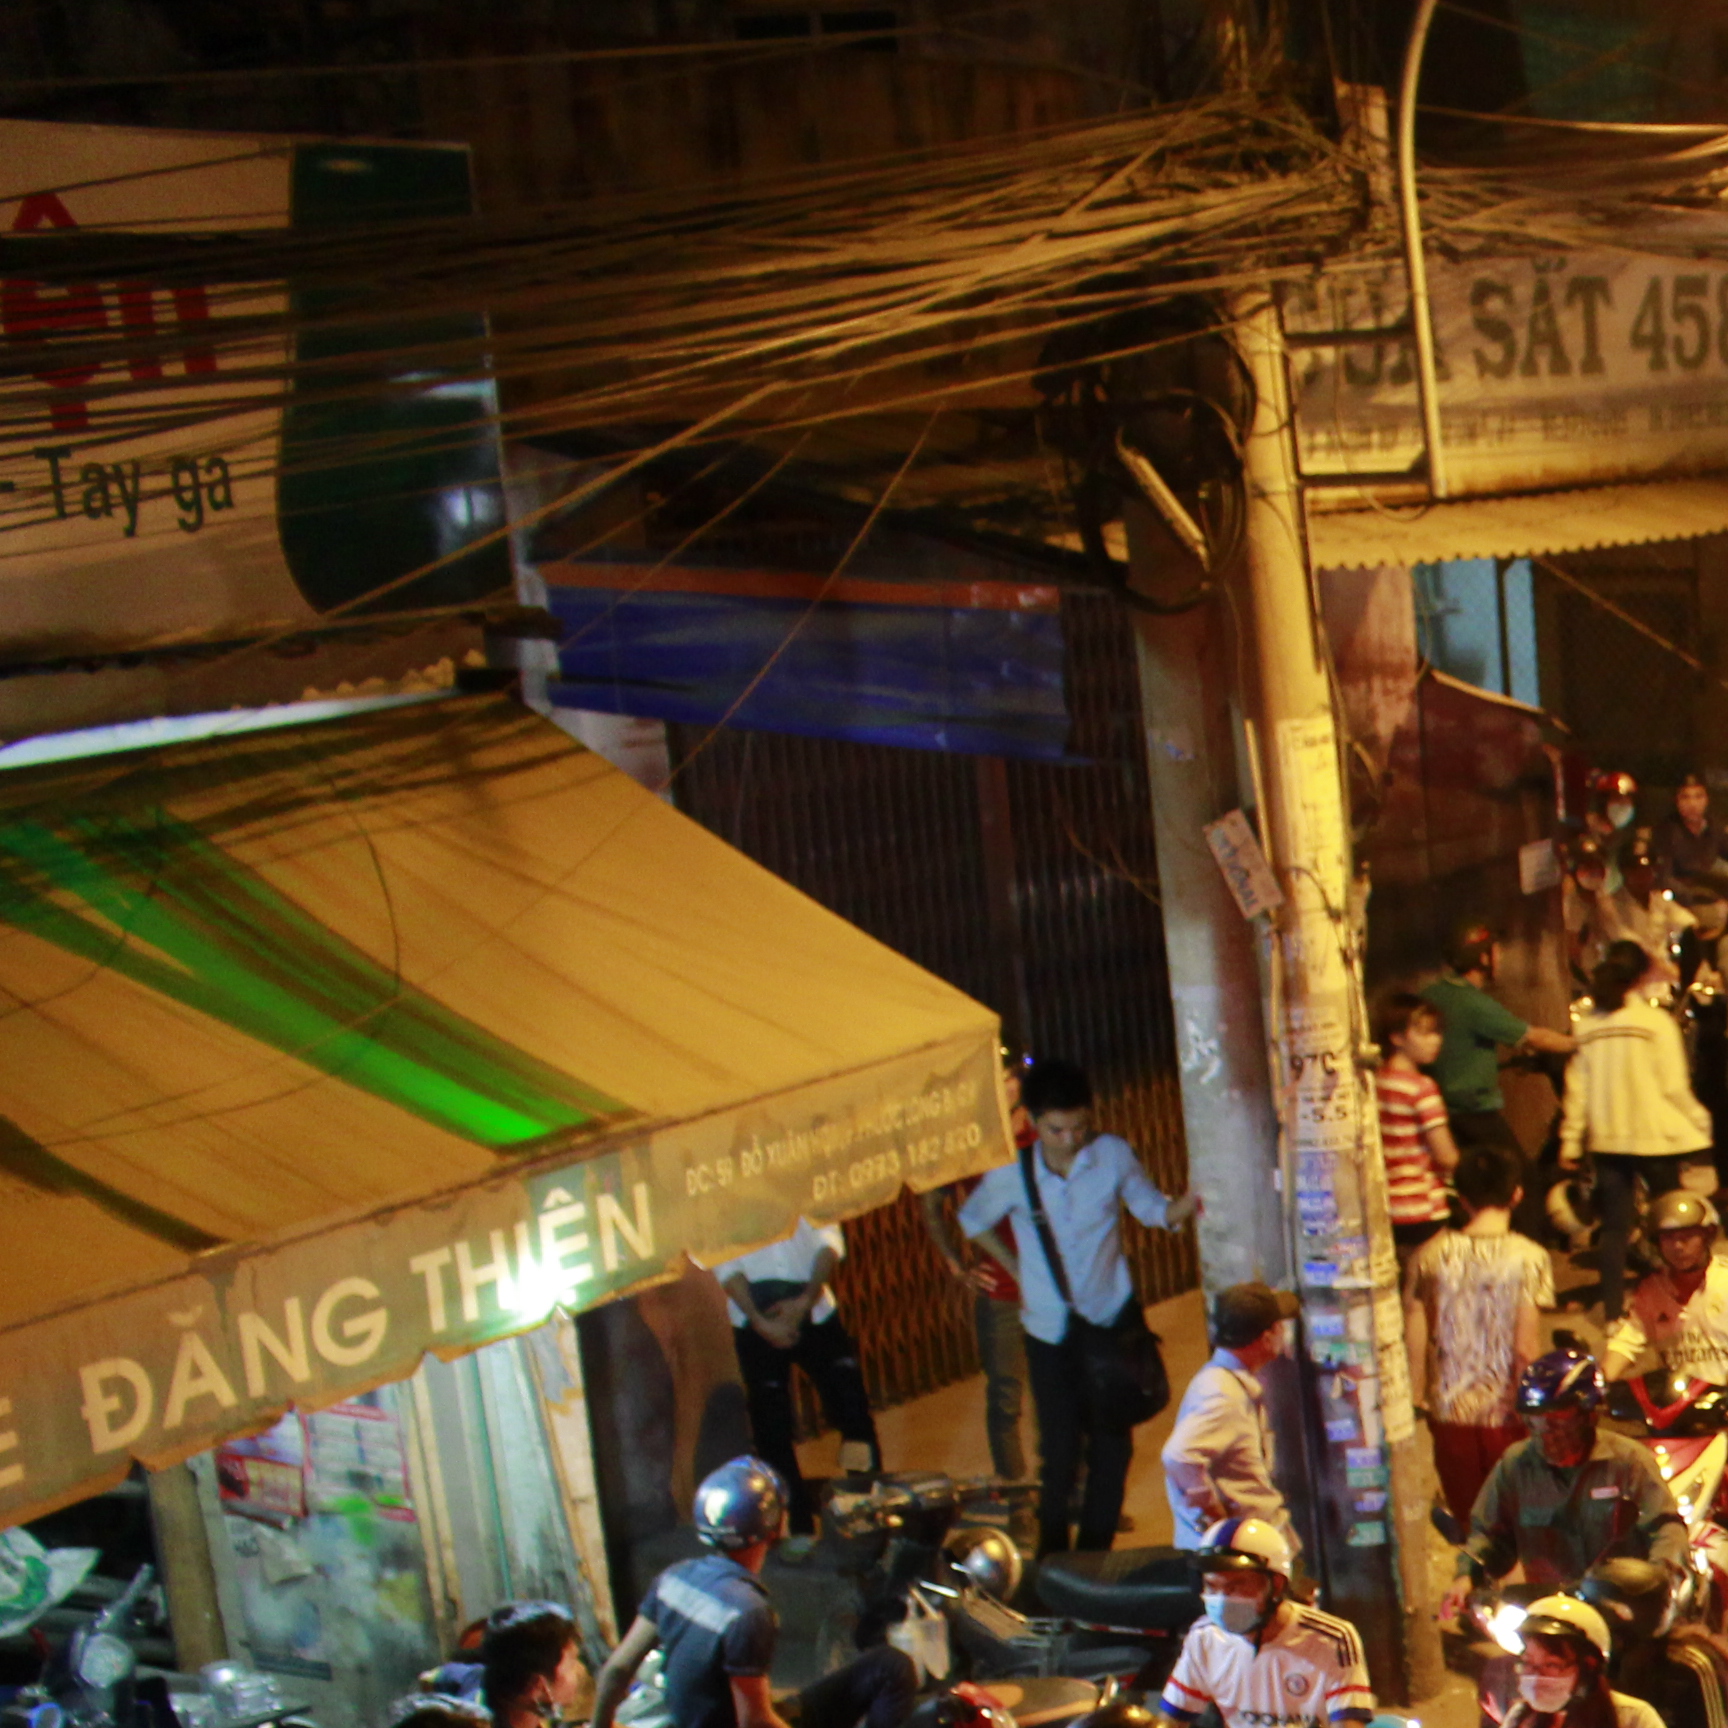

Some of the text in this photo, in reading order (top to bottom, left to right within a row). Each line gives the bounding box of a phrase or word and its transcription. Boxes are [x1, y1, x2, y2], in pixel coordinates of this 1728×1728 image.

[34, 446, 140, 538] Tay
[171, 456, 235, 533] ga
[80, 1277, 390, 1456] ĐĂNG
